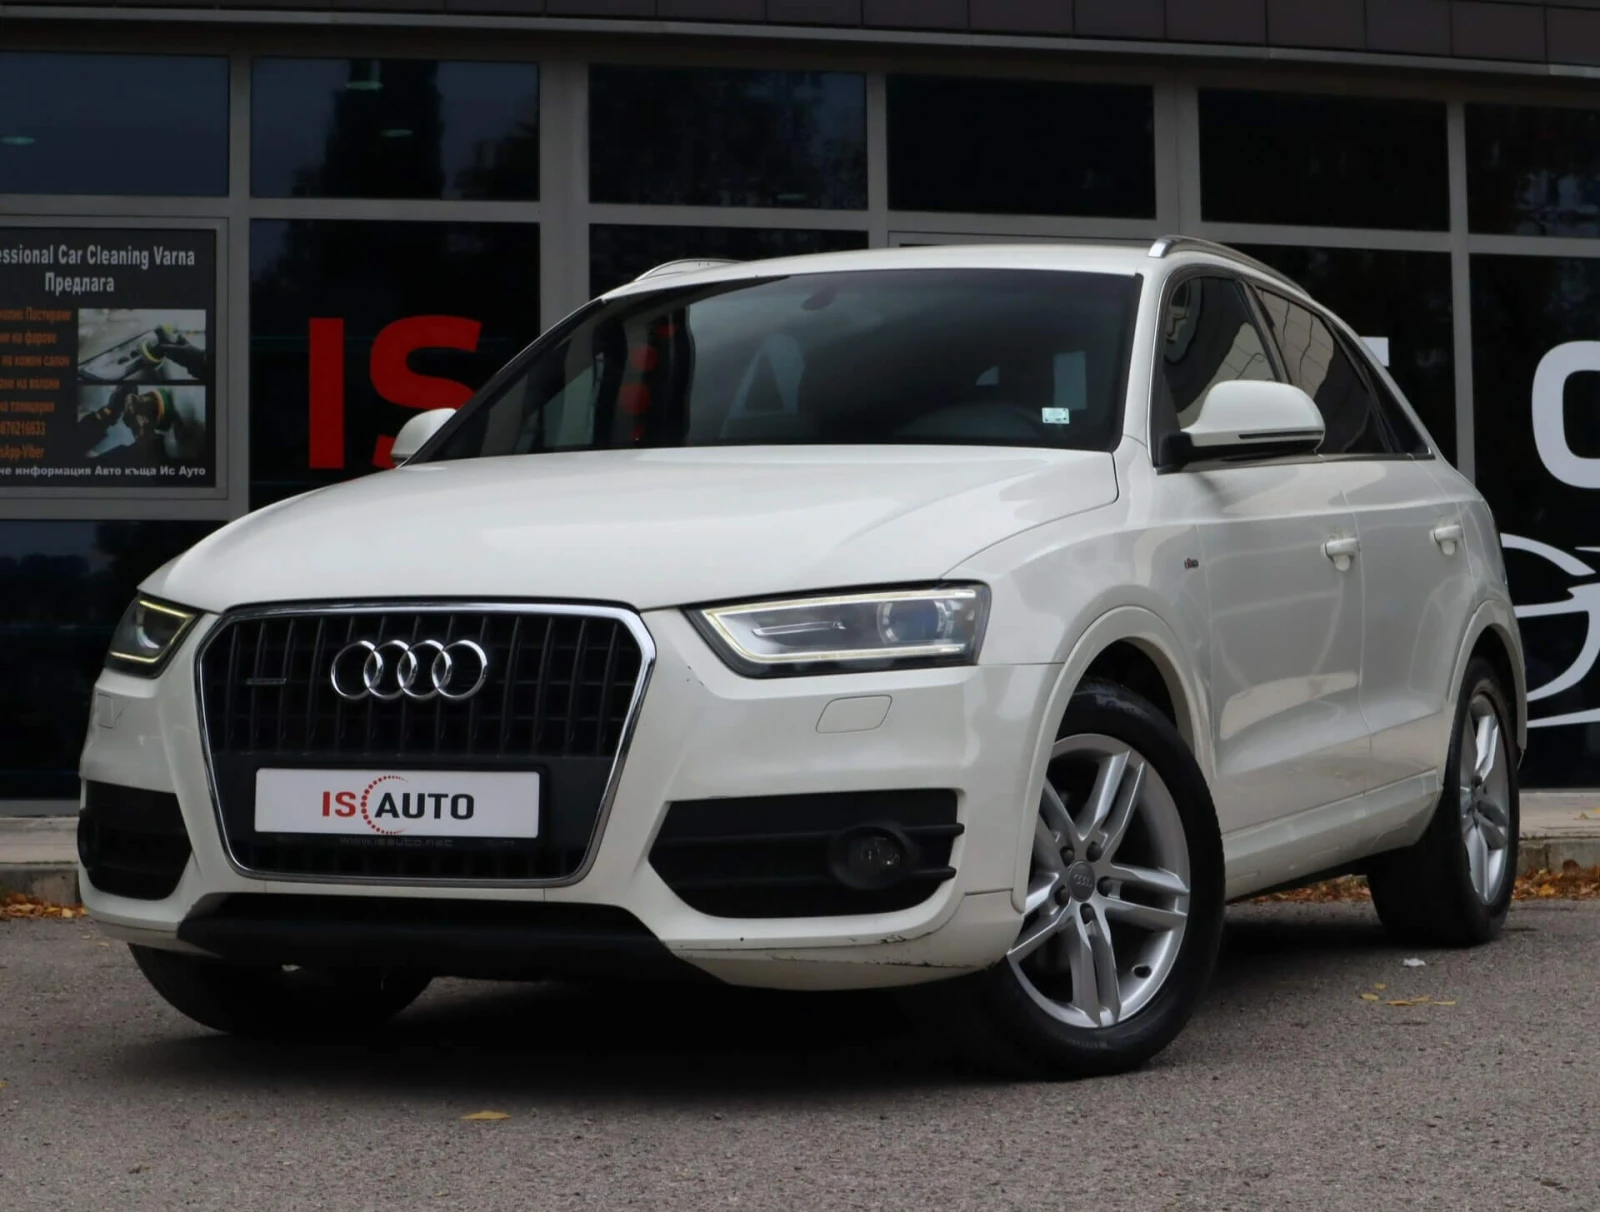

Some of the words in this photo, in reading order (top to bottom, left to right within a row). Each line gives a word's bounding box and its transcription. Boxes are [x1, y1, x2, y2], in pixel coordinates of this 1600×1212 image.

[58, 244, 83, 265] Car
[87, 245, 150, 271] Cleaning
[154, 246, 195, 267] Varna
[45, 272, 115, 296] Предлага
[15, 465, 92, 478] информация
[95, 466, 122, 476] Авто
[125, 467, 157, 477] къща
[160, 466, 175, 476] Ис
[179, 466, 206, 478] Ауто
[322, 791, 357, 818] IS
[374, 792, 475, 820] AUTO
